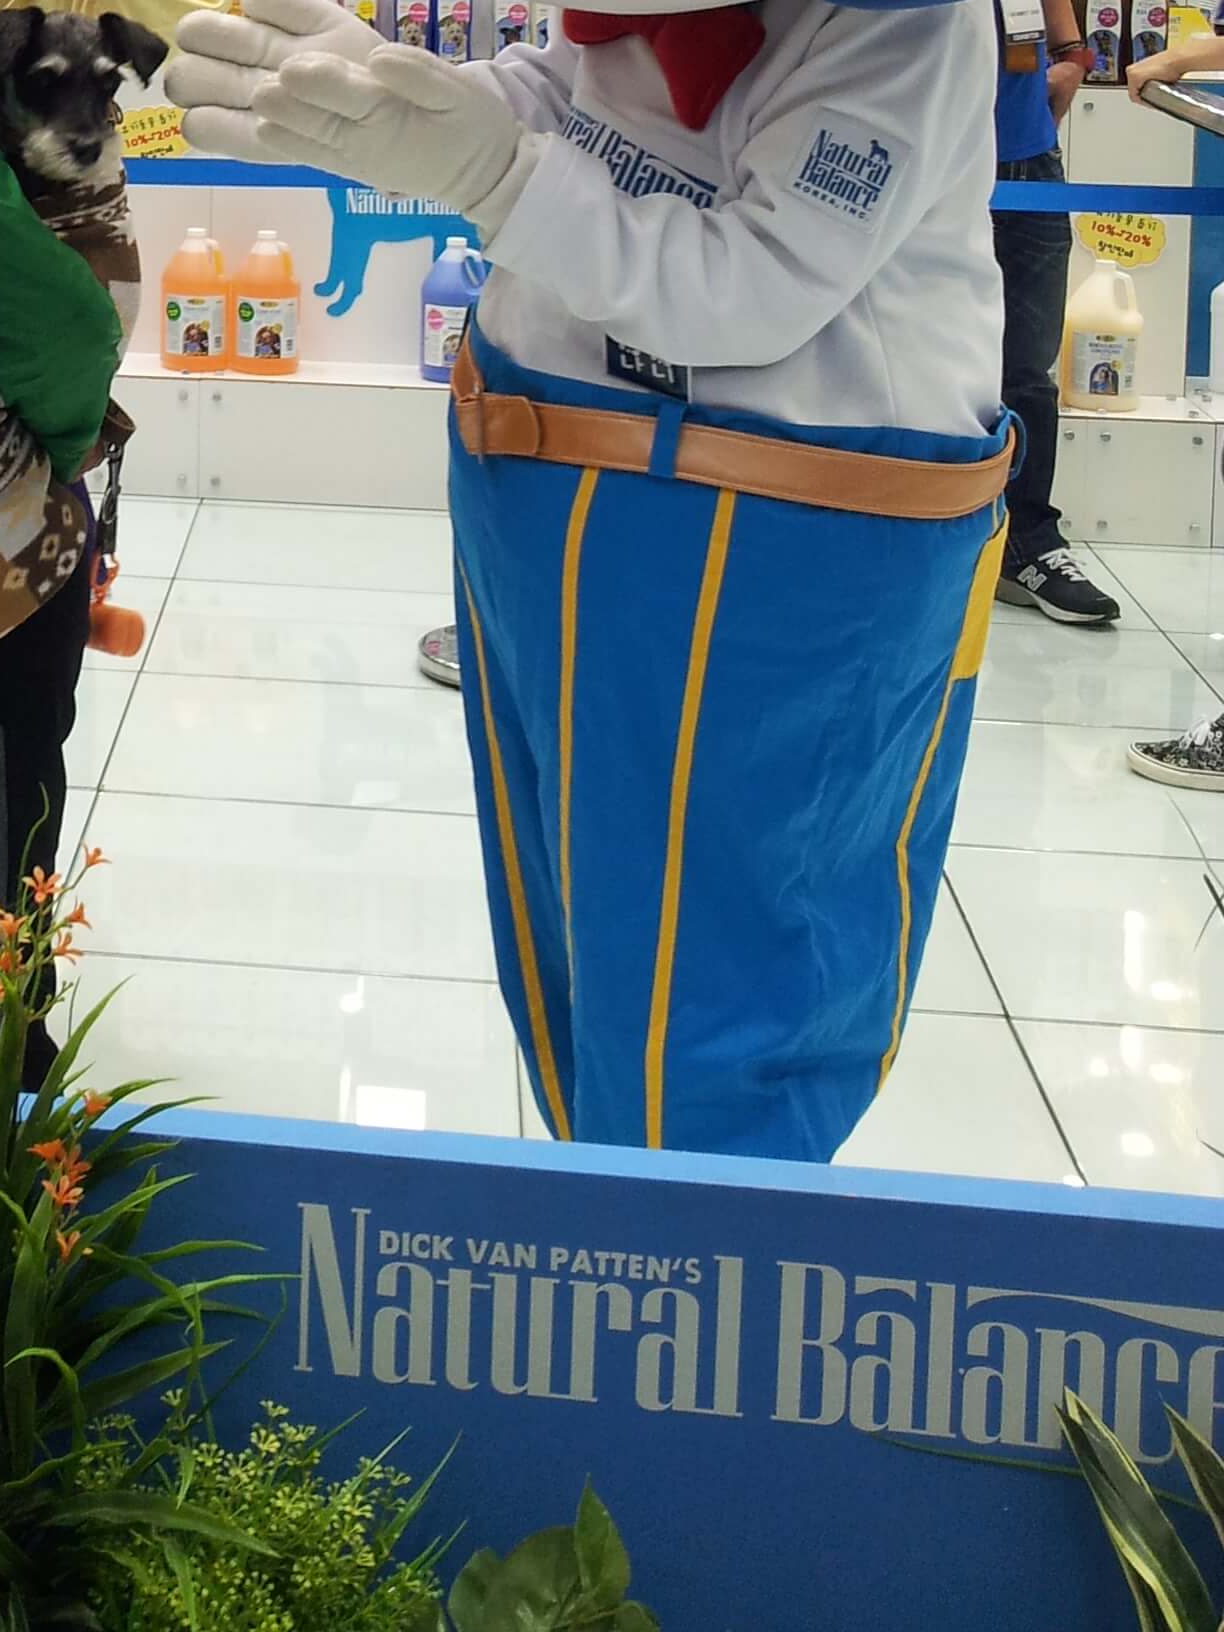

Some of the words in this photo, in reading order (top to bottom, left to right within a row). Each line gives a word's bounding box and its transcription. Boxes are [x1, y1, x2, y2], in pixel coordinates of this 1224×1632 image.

[799, 152, 881, 209] Balance
[807, 129, 893, 187] Natural
[378, 1229, 454, 1261] DICK
[466, 1239, 537, 1269] VAN
[550, 1246, 703, 1285] PATTEN'S
[294, 1201, 744, 1419] Natural
